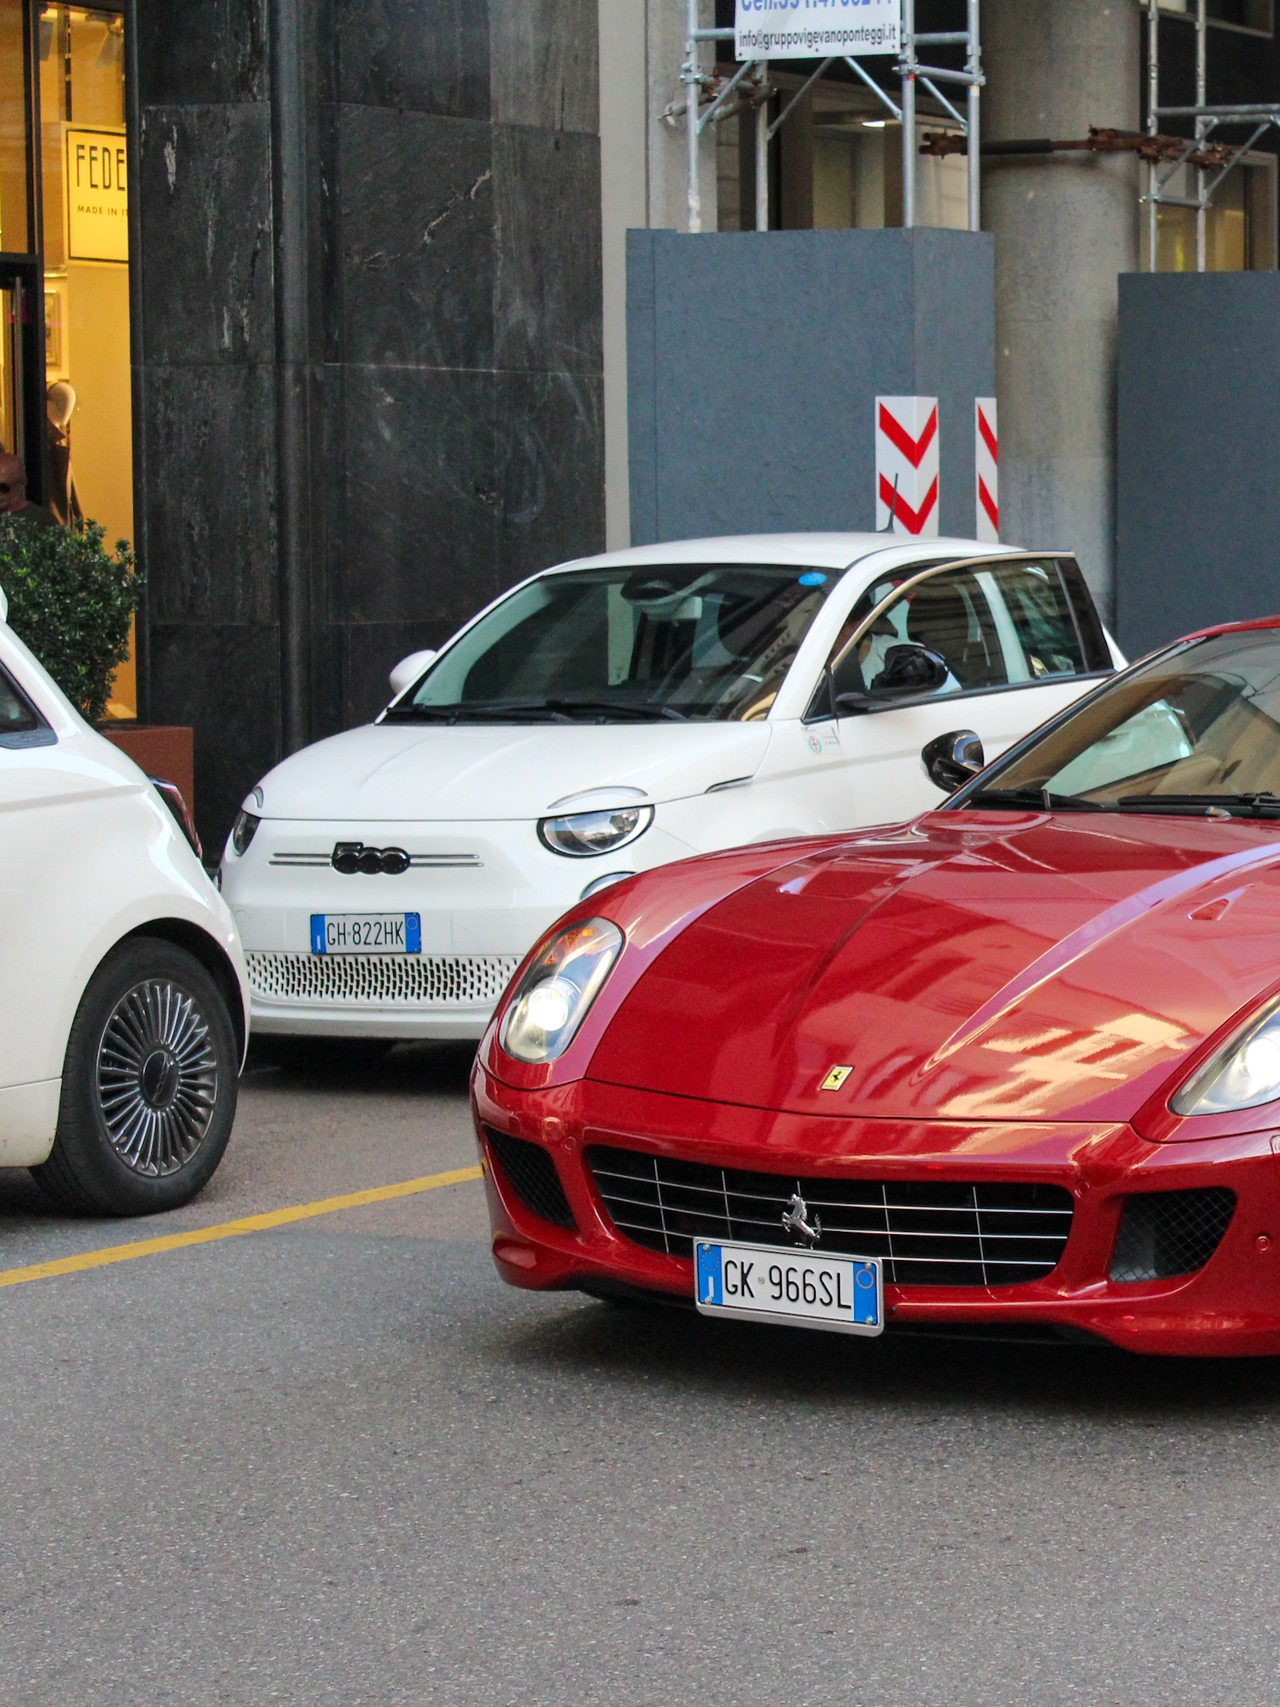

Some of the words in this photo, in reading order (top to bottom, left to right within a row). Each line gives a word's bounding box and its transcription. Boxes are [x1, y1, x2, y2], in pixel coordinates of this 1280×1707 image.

[739, 24, 896, 49] info@gruppovigevanoponteggi.it
[76, 144, 126, 191] FEDE
[77, 205, 103, 215] MADE
[107, 207, 118, 216] IN
[331, 842, 410, 875] 500
[326, 922, 346, 946] GH
[352, 921, 404, 946] 822HK
[724, 1260, 755, 1298] GK
[768, 1265, 852, 1310] 966SL
